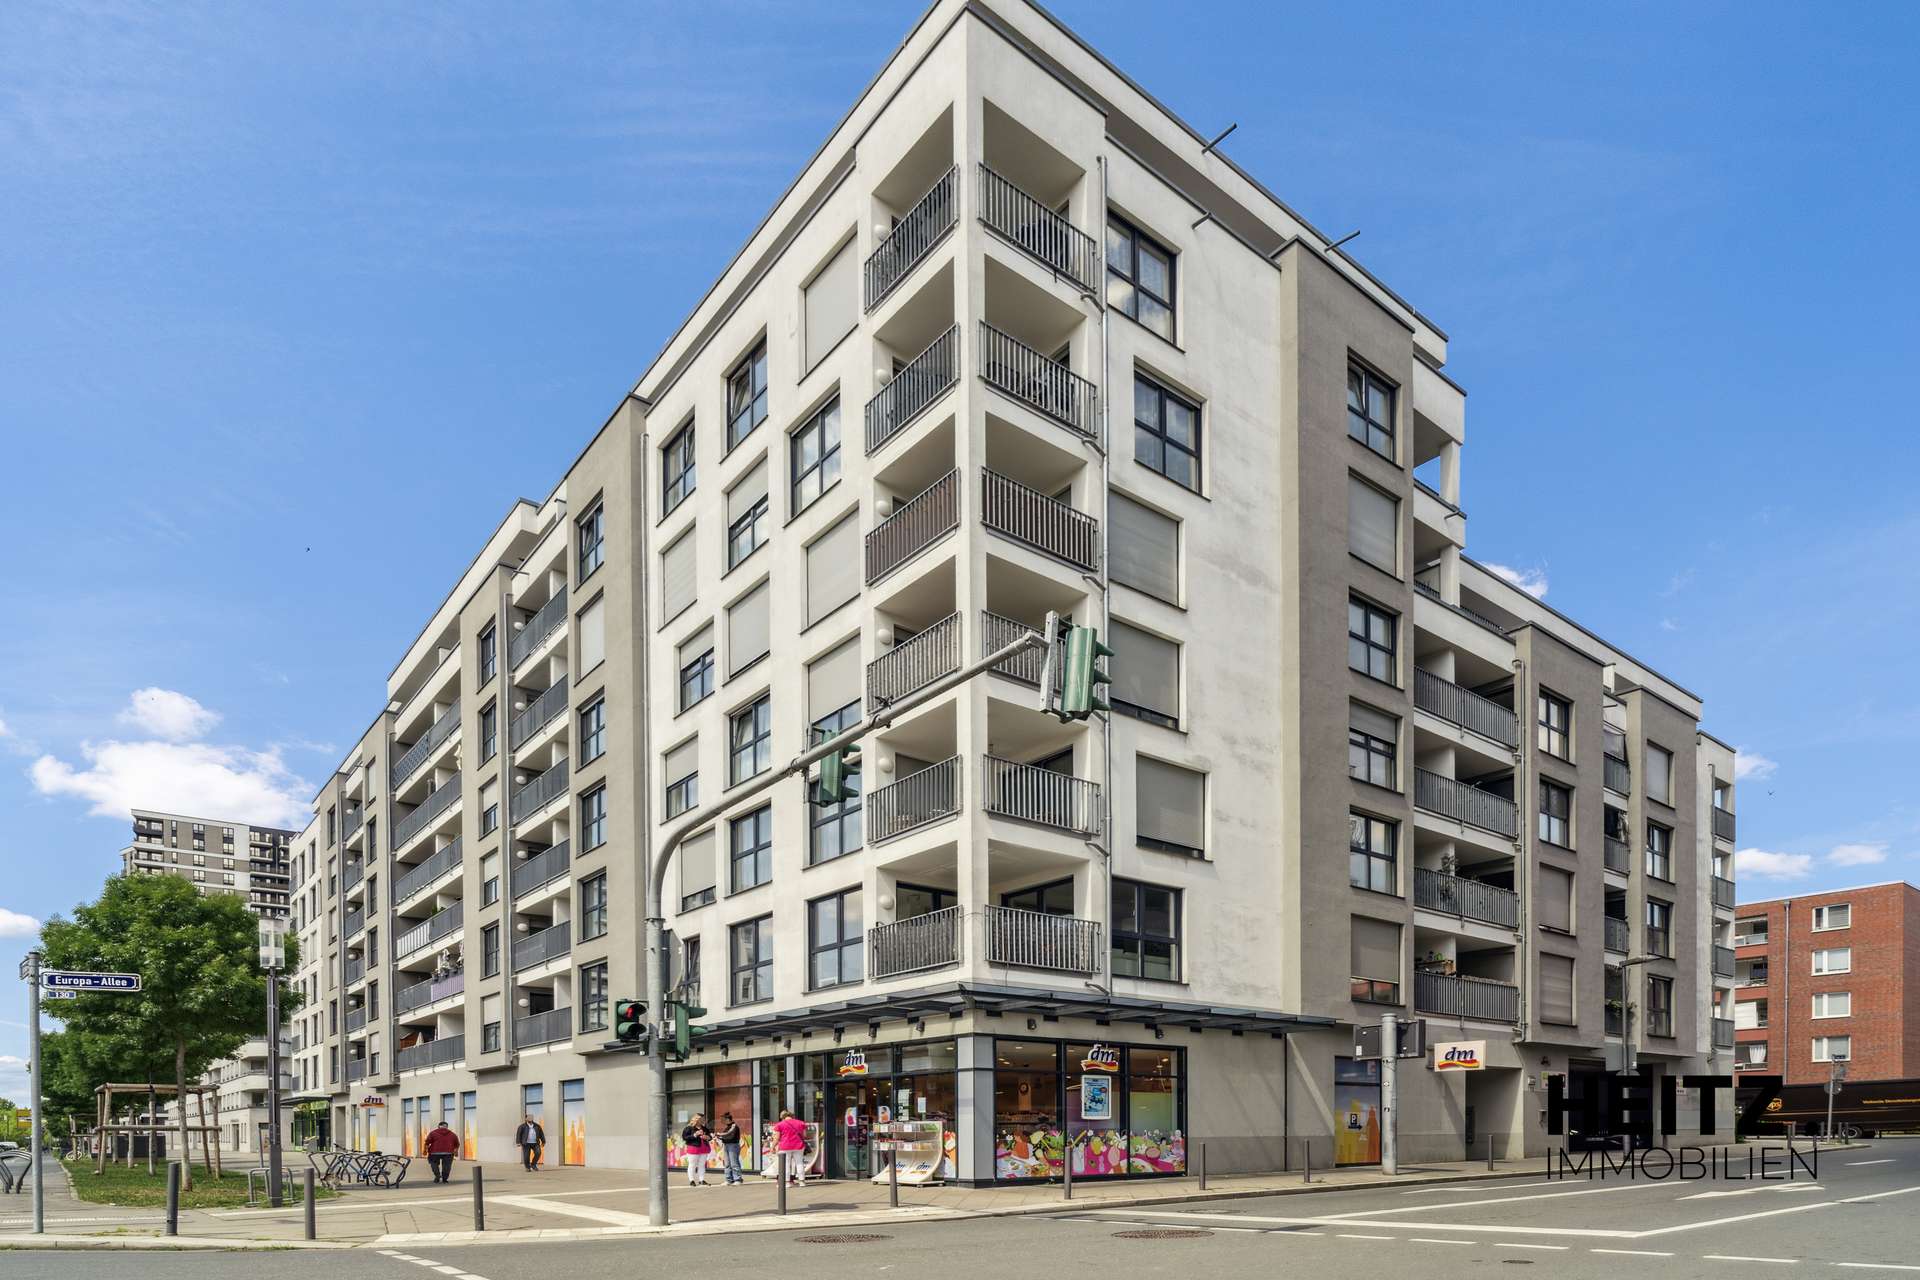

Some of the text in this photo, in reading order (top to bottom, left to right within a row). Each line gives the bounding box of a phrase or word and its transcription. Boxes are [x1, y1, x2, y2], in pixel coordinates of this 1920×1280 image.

[55, 975, 127, 987] Europa-Allee
[845, 1051, 863, 1065] dm
[1091, 1045, 1115, 1061] dm
[1445, 1046, 1474, 1060] dm
[364, 1096, 383, 1104] dm
